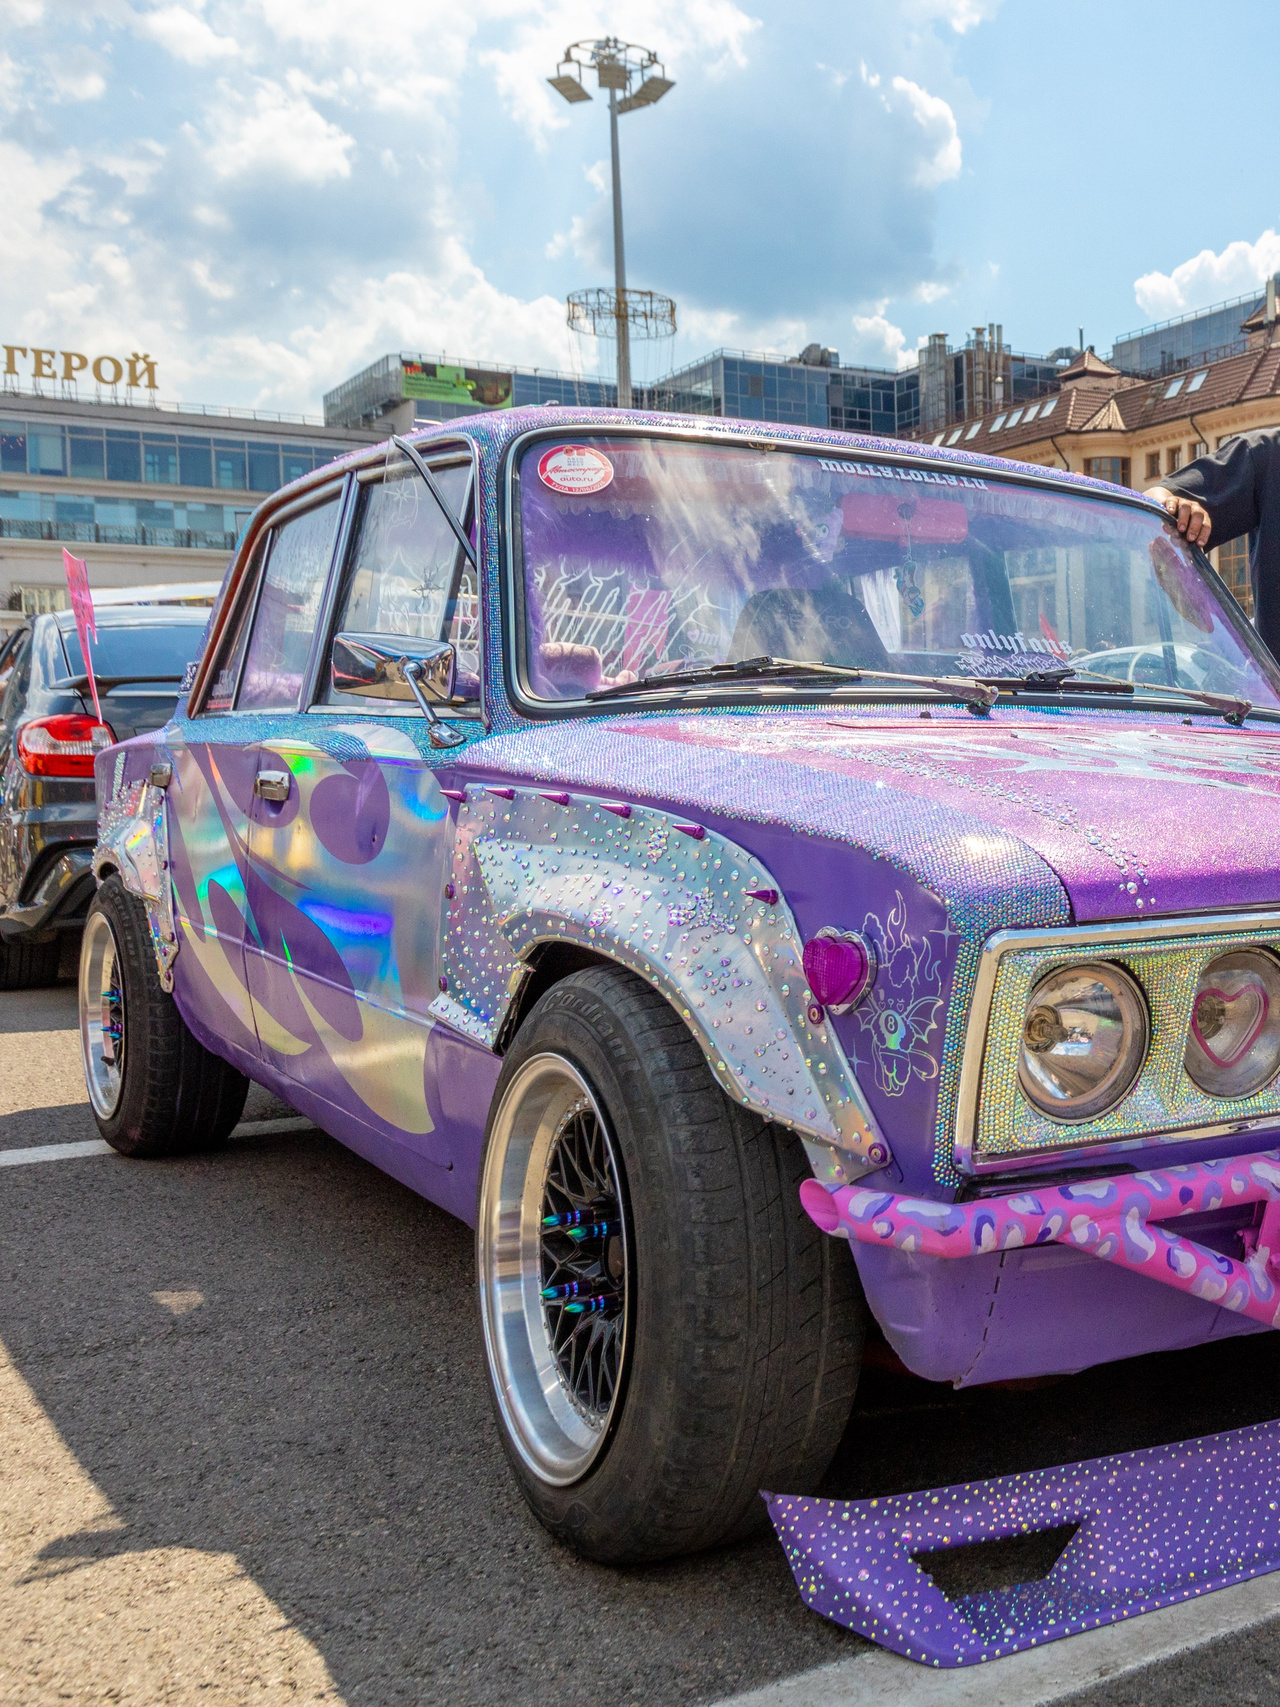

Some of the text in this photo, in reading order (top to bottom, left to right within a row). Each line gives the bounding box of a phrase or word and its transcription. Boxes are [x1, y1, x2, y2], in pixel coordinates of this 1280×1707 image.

[2, 344, 159, 390] ГЕРОЙ
[551, 481, 569, 492] ТУЛА
[960, 629, 1074, 656] onlyfans
[887, 1015, 896, 1032] 8
